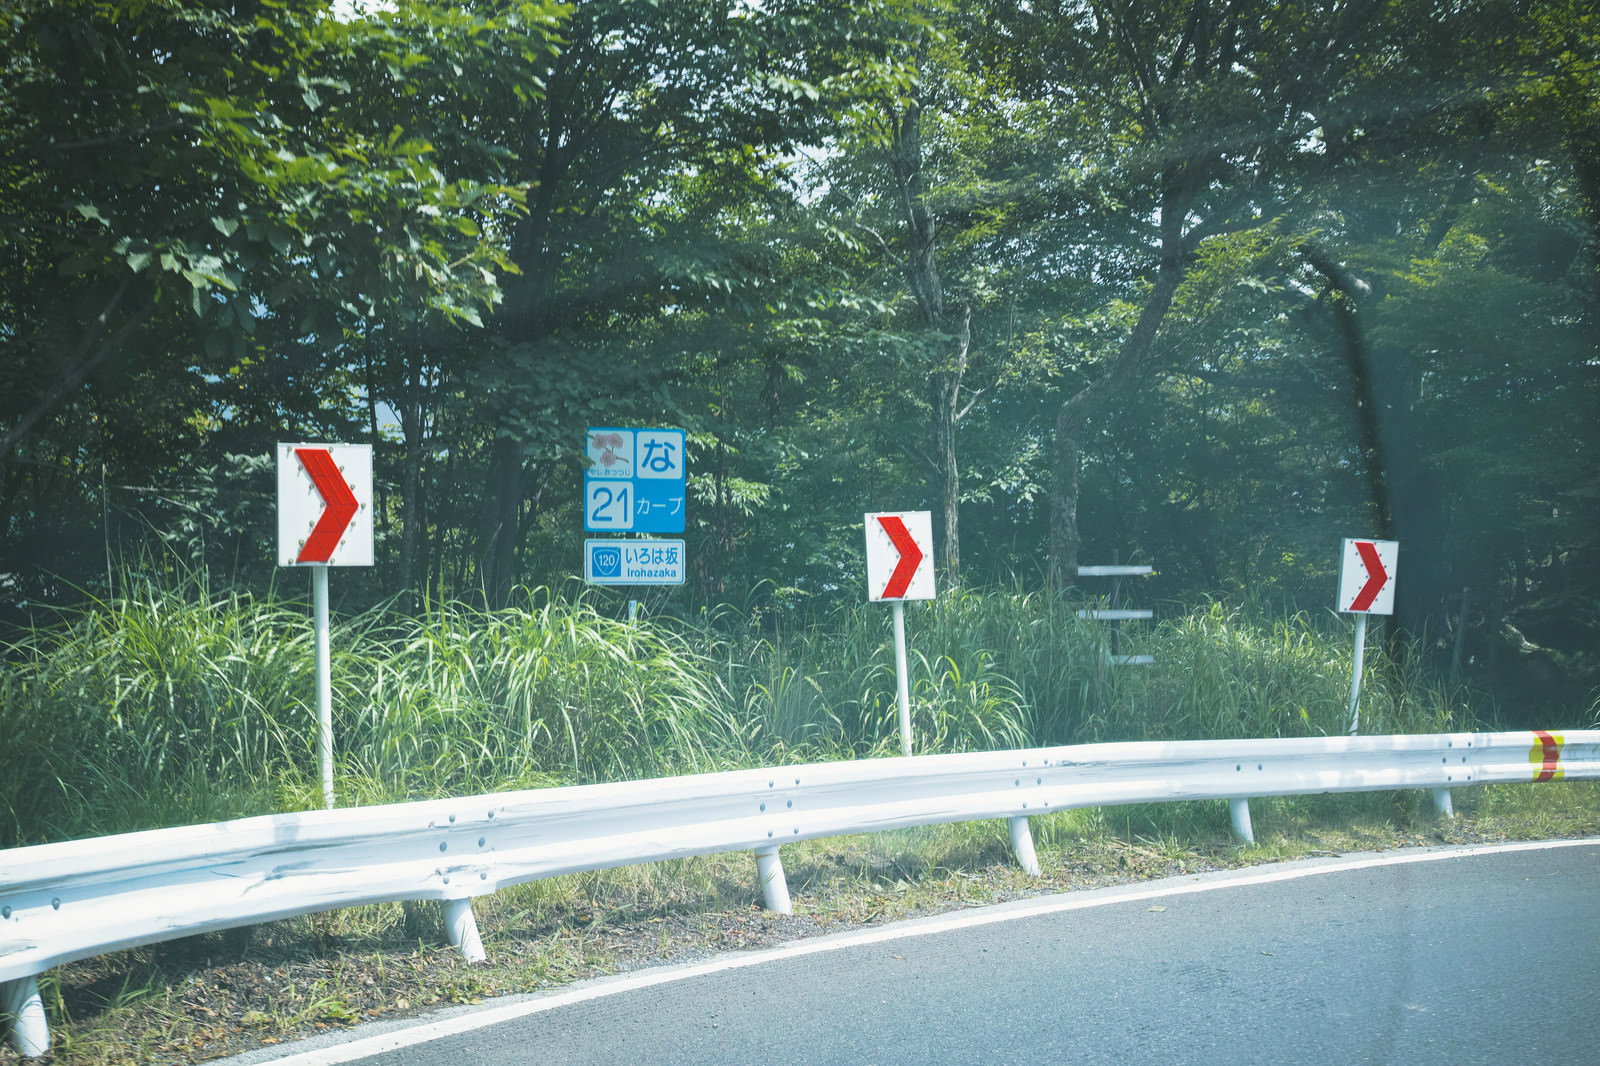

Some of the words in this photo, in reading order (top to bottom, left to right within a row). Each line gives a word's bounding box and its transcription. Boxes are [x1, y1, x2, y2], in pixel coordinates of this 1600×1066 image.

[642, 438, 676, 473] な
[592, 487, 628, 523] 21
[599, 554, 615, 567] 120
[625, 547, 678, 565] いろは坂
[627, 567, 677, 577] Irohazaka
